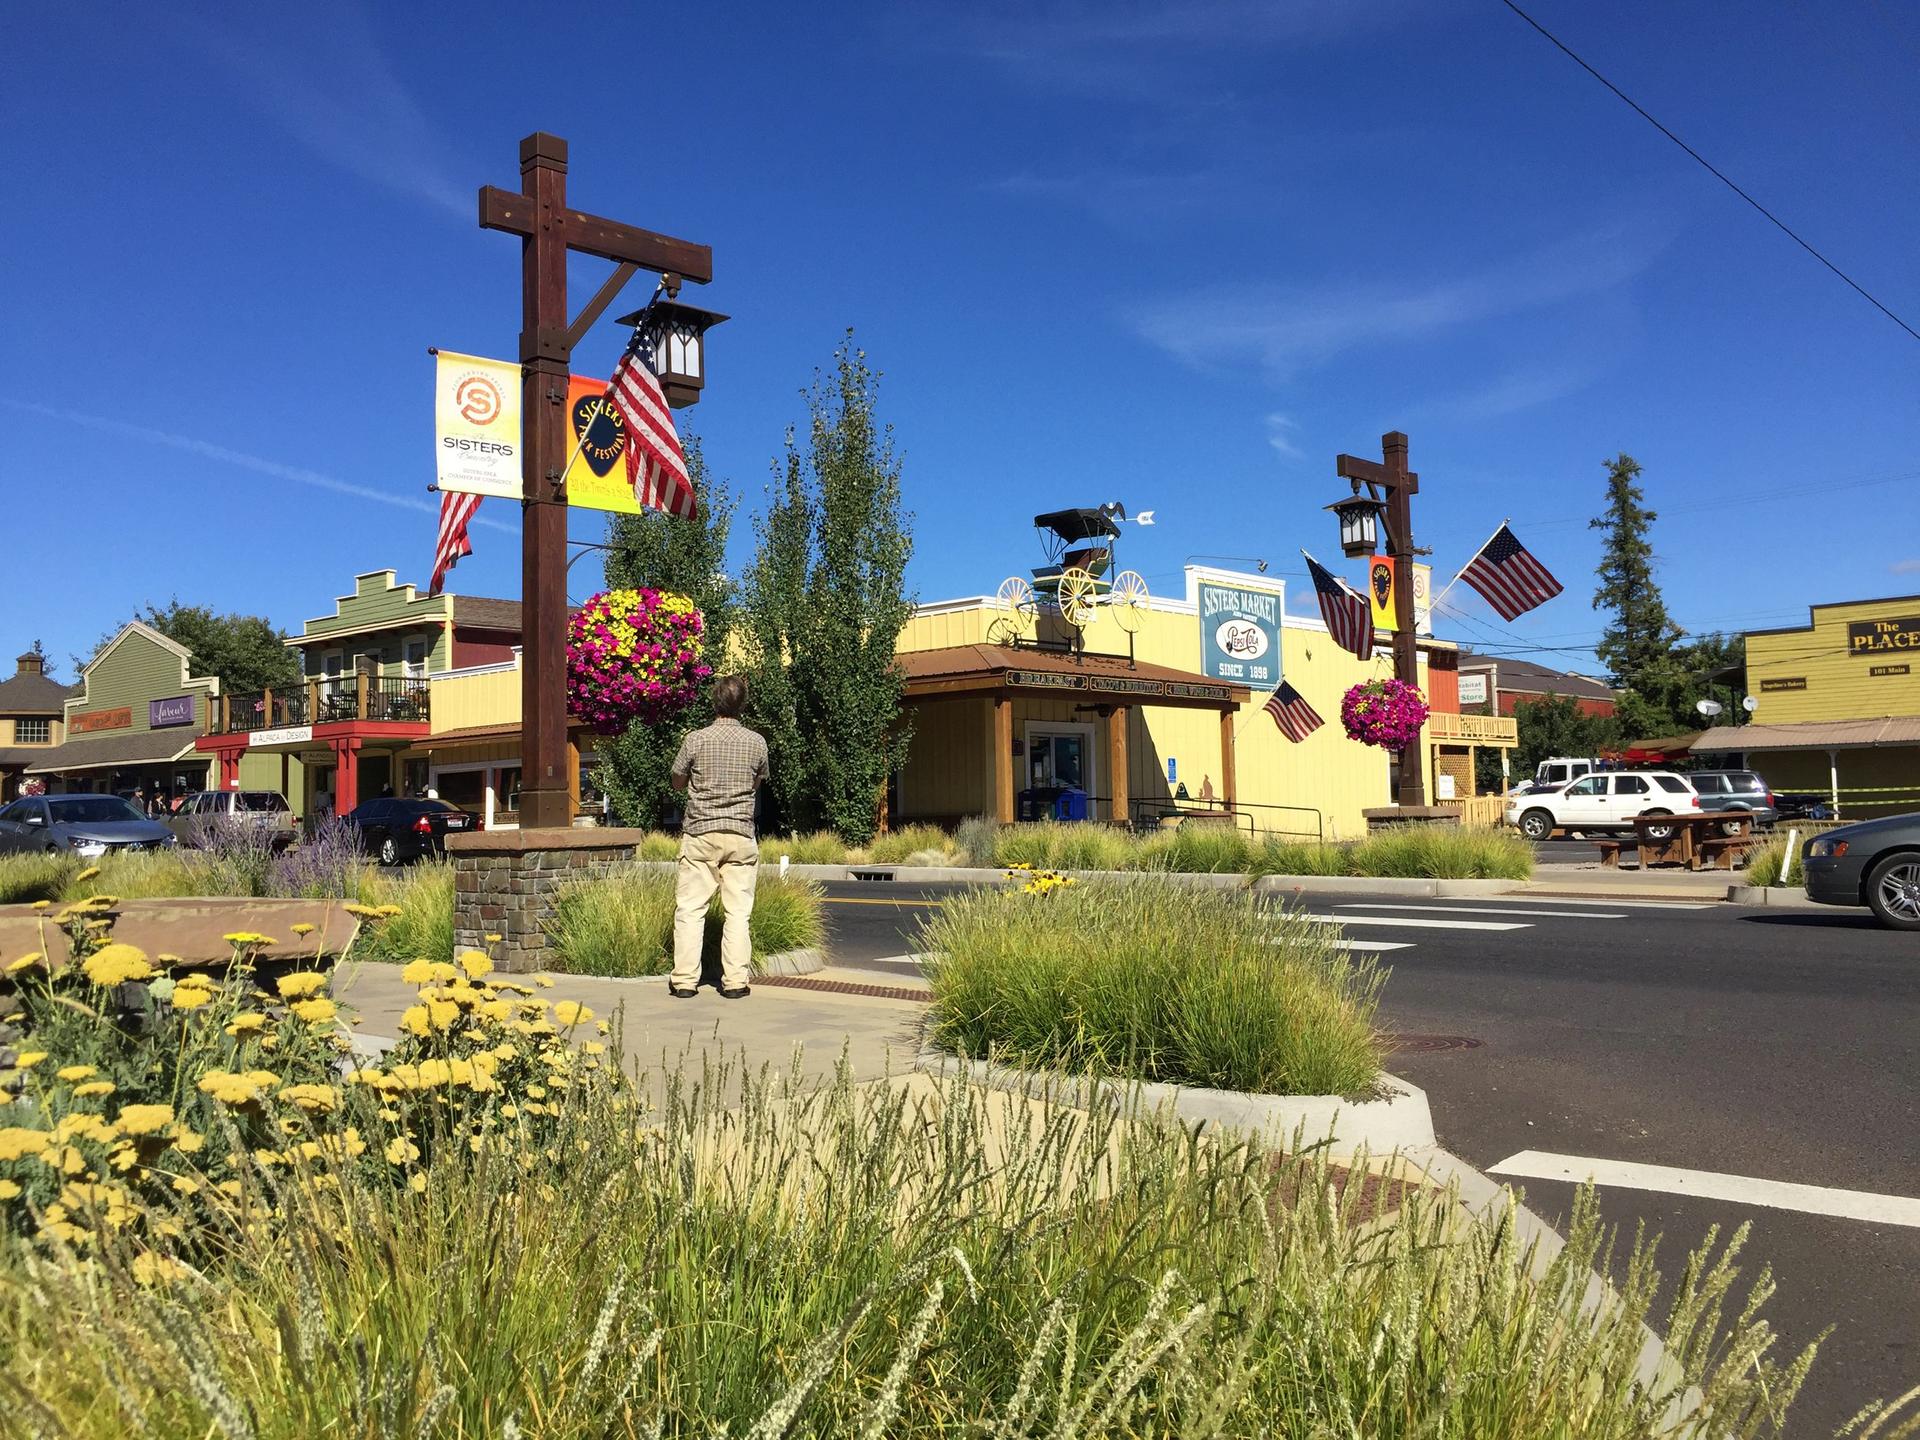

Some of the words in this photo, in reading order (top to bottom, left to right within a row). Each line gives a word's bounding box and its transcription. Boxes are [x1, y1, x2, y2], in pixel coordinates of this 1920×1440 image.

[443, 436, 513, 456] SISTERS
[594, 432, 625, 460] FESTIVAL
[1204, 587, 1240, 618] SISTERS
[1240, 592, 1276, 626] MARKET
[1875, 622, 1899, 633] The
[1854, 632, 1920, 651] PLACE
[1219, 662, 1244, 678] SINCE
[1249, 665, 1268, 680] 1898
[1874, 667, 1886, 675] 101
[1888, 666, 1906, 674] Main
[287, 730, 309, 740] DESIGN
